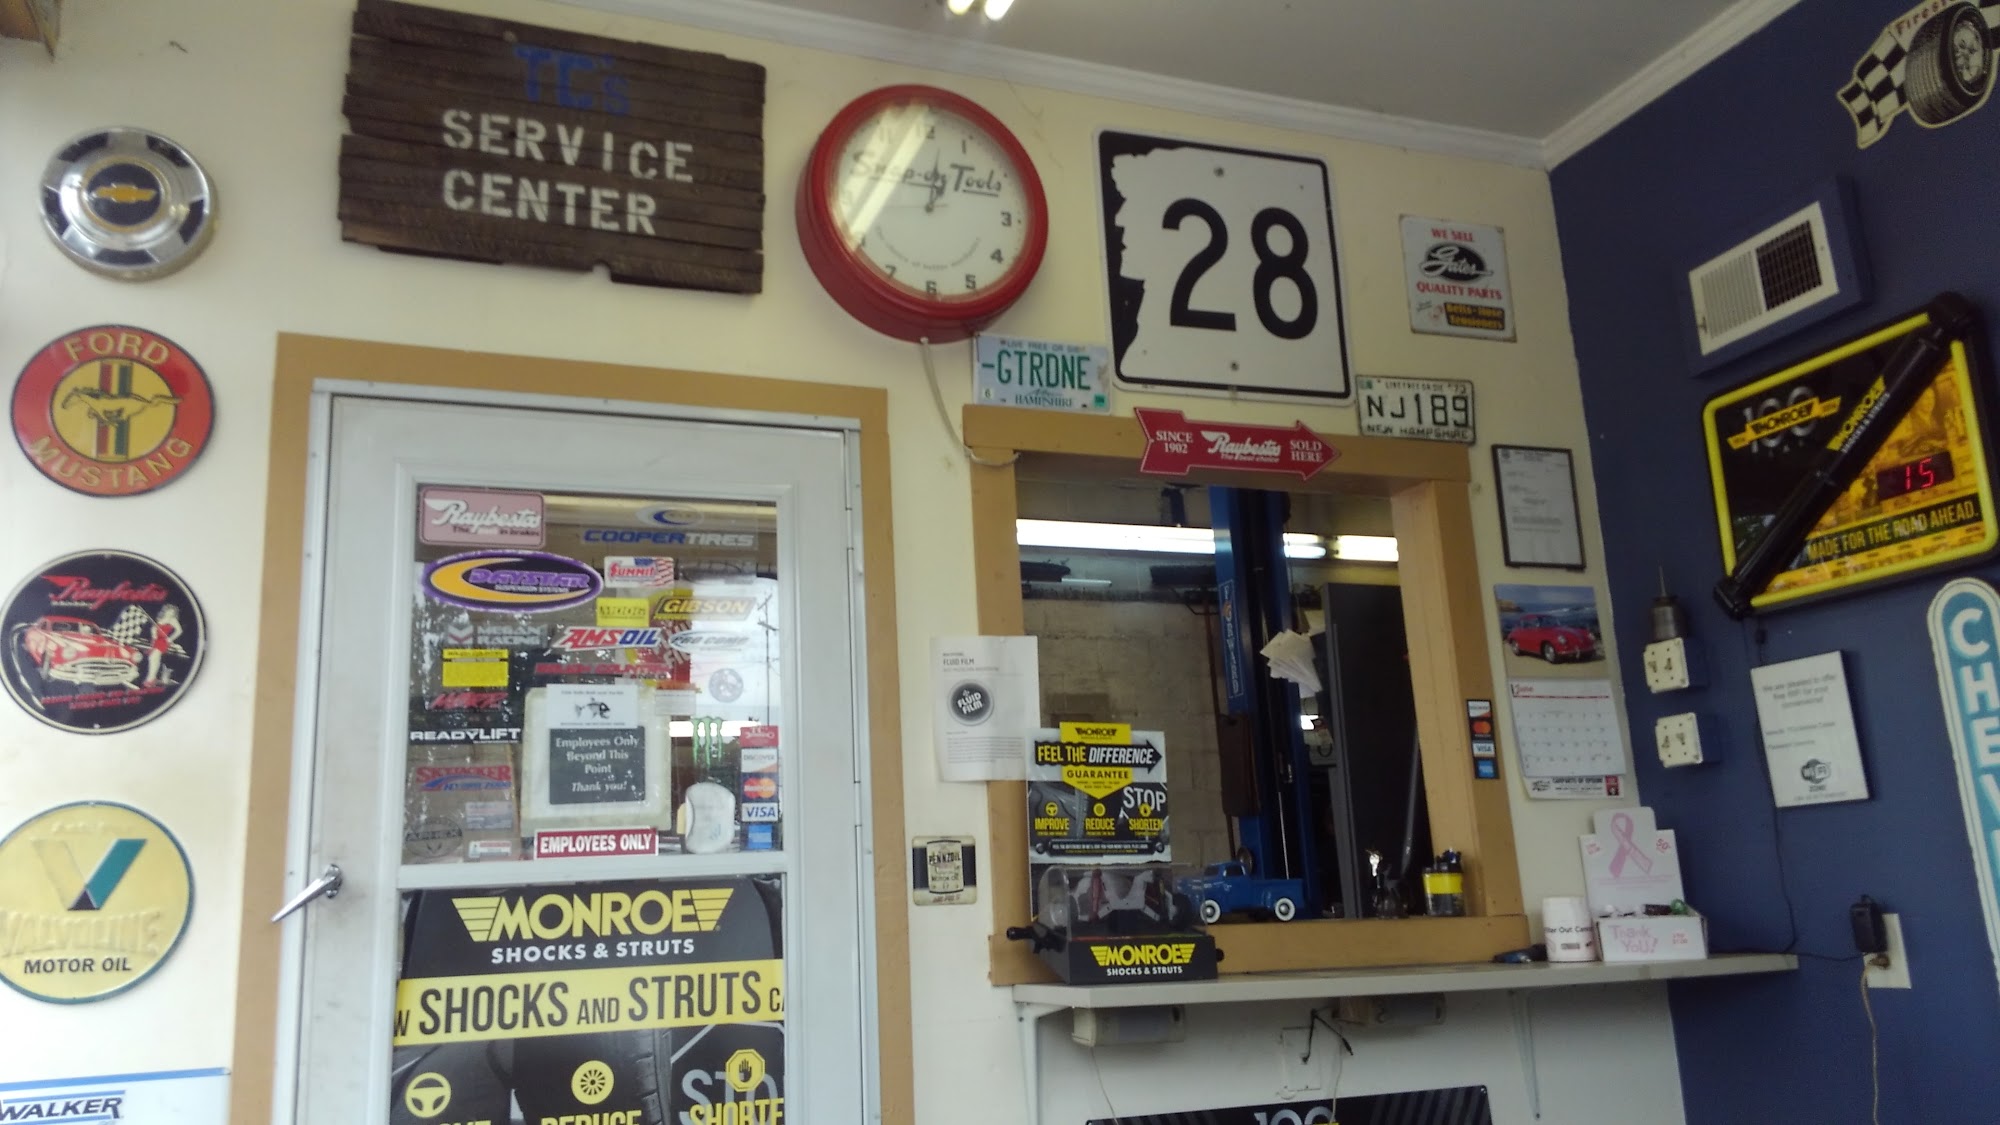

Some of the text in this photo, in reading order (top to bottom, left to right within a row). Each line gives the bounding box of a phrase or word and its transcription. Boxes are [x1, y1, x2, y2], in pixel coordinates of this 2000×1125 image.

[1895, 0, 1952, 36] Firest
[442, 108, 694, 183] SERVICE
[950, 163, 1002, 192] Tools
[443, 169, 656, 235] CENTER
[1001, 211, 1012, 227] 3
[1431, 228, 1474, 242] WE SELL
[990, 249, 1003, 263] 4
[885, 265, 897, 280] 7
[1162, 197, 1319, 340] 28
[925, 281, 938, 295] 6
[965, 274, 976, 290] 5
[1416, 281, 1503, 300] QUALITY PARTS
[63, 332, 169, 366] FORD
[1751, 401, 1813, 434] MONROE
[1156, 430, 1194, 443] SINCE
[1367, 425, 1469, 440] NEW HAMPSHIRE
[1163, 443, 1188, 454] 1902
[1201, 430, 1281, 459] Raybestos
[1290, 439, 1322, 453] SOLD
[30, 436, 193, 490] MUSTANG
[1291, 451, 1324, 463] HERE
[1905, 458, 1934, 490] 15
[424, 498, 542, 534] Raybestos
[1808, 538, 1840, 561] MADE
[1843, 531, 1866, 550] FOR
[1868, 524, 1892, 544] THE
[1893, 513, 1927, 537] ROAD
[664, 598, 747, 614] GIBSON
[561, 629, 659, 648] AMSOIL
[957, 691, 982, 708] FLUID
[962, 700, 983, 715] FILM
[410, 728, 522, 741] READYLIFT
[1077, 727, 1116, 736] MONROE
[556, 734, 640, 750] Employees Only
[566, 749, 630, 763] Beyond This
[1037, 745, 1064, 763] FEEL
[1065, 745, 1087, 763] THE
[584, 763, 612, 774] Point
[1066, 769, 1129, 779] GUARANTEE
[572, 781, 628, 794] Thank you!
[1122, 785, 1167, 812] STOP
[746, 807, 776, 818] VISA
[1034, 818, 1070, 831] IMPROVE
[1085, 818, 1115, 831] REDUCE
[1128, 818, 1164, 831] SHORTEN
[540, 832, 652, 854] EMPLOYEES ONLY
[484, 889, 706, 942] MONROE
[1608, 925, 1650, 939] Thank
[491, 938, 695, 964] SHOCKS & STRUTS
[1100, 944, 1186, 967] MONROE
[24, 956, 132, 975] MOTOR OIL
[1106, 965, 1183, 976] SHOCKS & STRUTS
[419, 980, 568, 1035] SHOCKS
[577, 997, 620, 1026] AND
[628, 970, 761, 1024] STRUTS
[0, 1097, 123, 1121] WALKER
